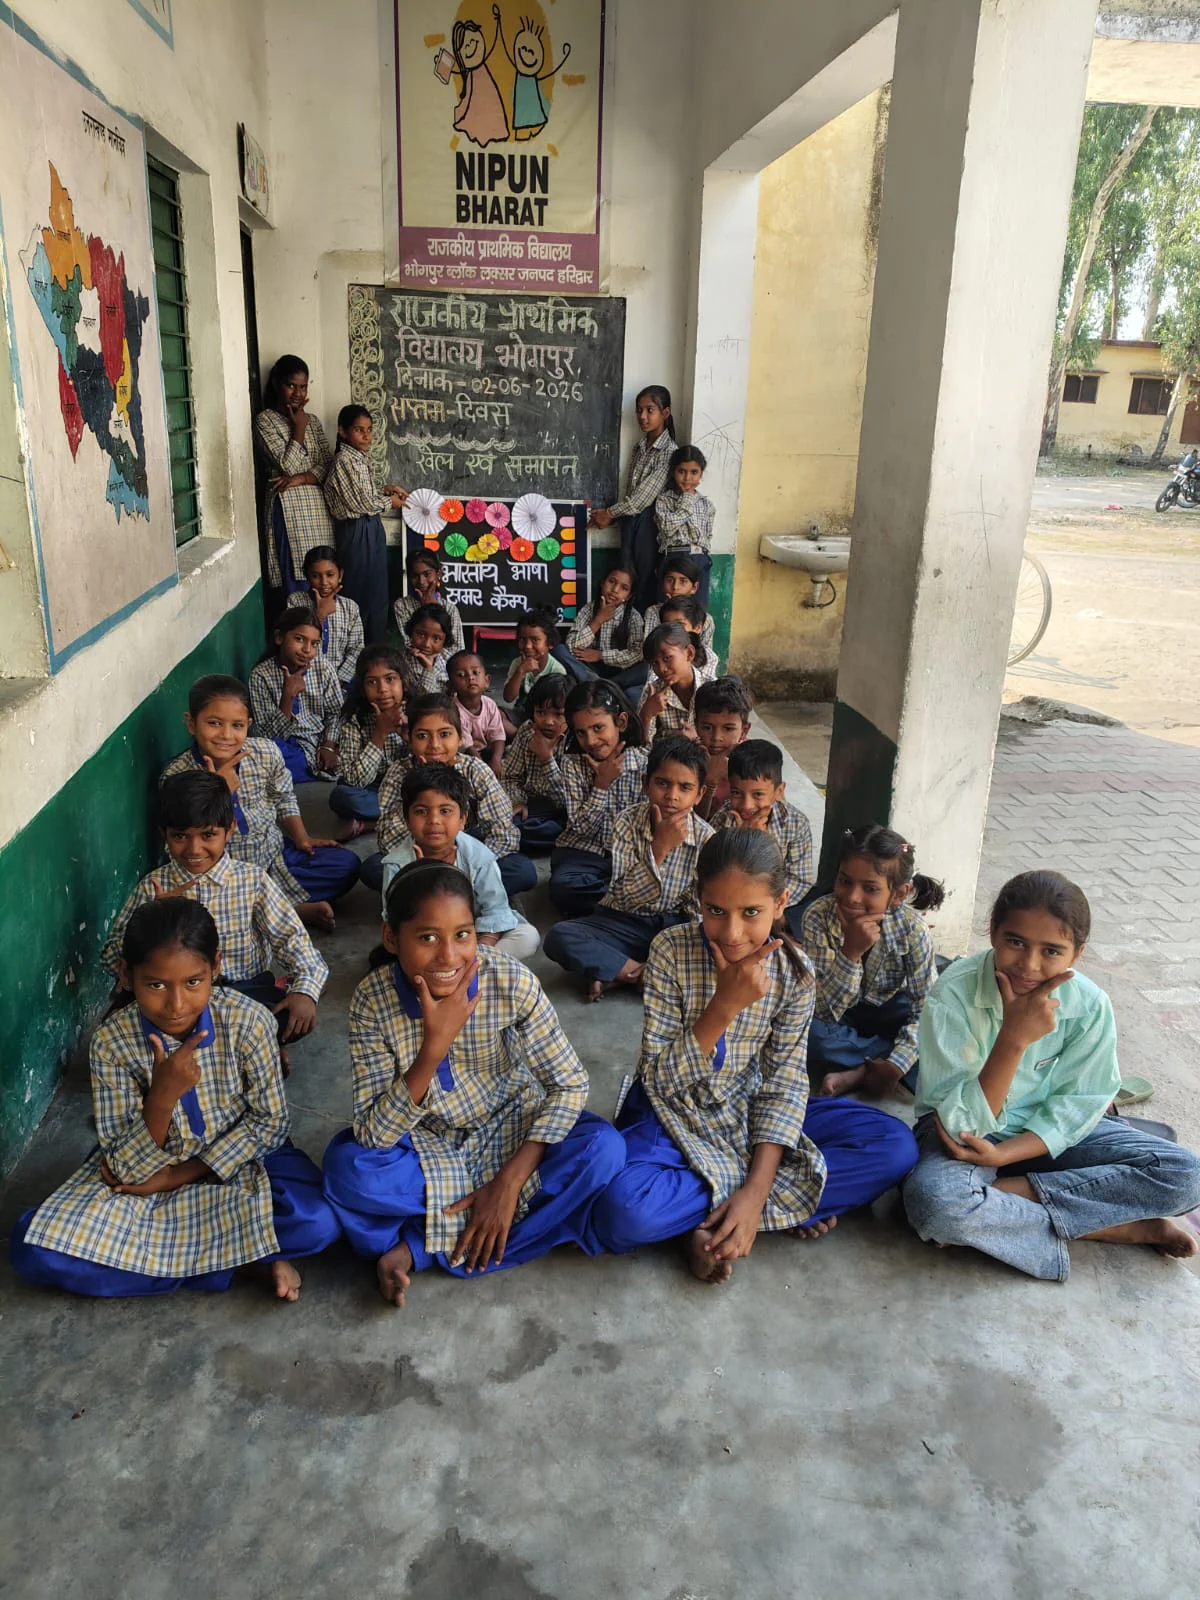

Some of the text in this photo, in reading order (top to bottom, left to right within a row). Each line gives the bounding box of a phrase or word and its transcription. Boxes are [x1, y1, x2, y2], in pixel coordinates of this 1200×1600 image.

[456, 152, 549, 194] NIPUN
[456, 194, 549, 227] BHARAT
[427, 232, 572, 261] राजकीय प्राथमिक विद्यालय
[404, 258, 594, 285] भोगपुर ब्लॉक लक्सर जनपद हरिद्वार
[390, 294, 598, 339] राजकीय प्राथमिक
[395, 325, 485, 371] विद्यालय
[416, 445, 454, 476] खेल
[504, 455, 579, 482] समापन
[440, 559, 548, 585] भारतीय भाषा
[445, 587, 483, 606] समर
